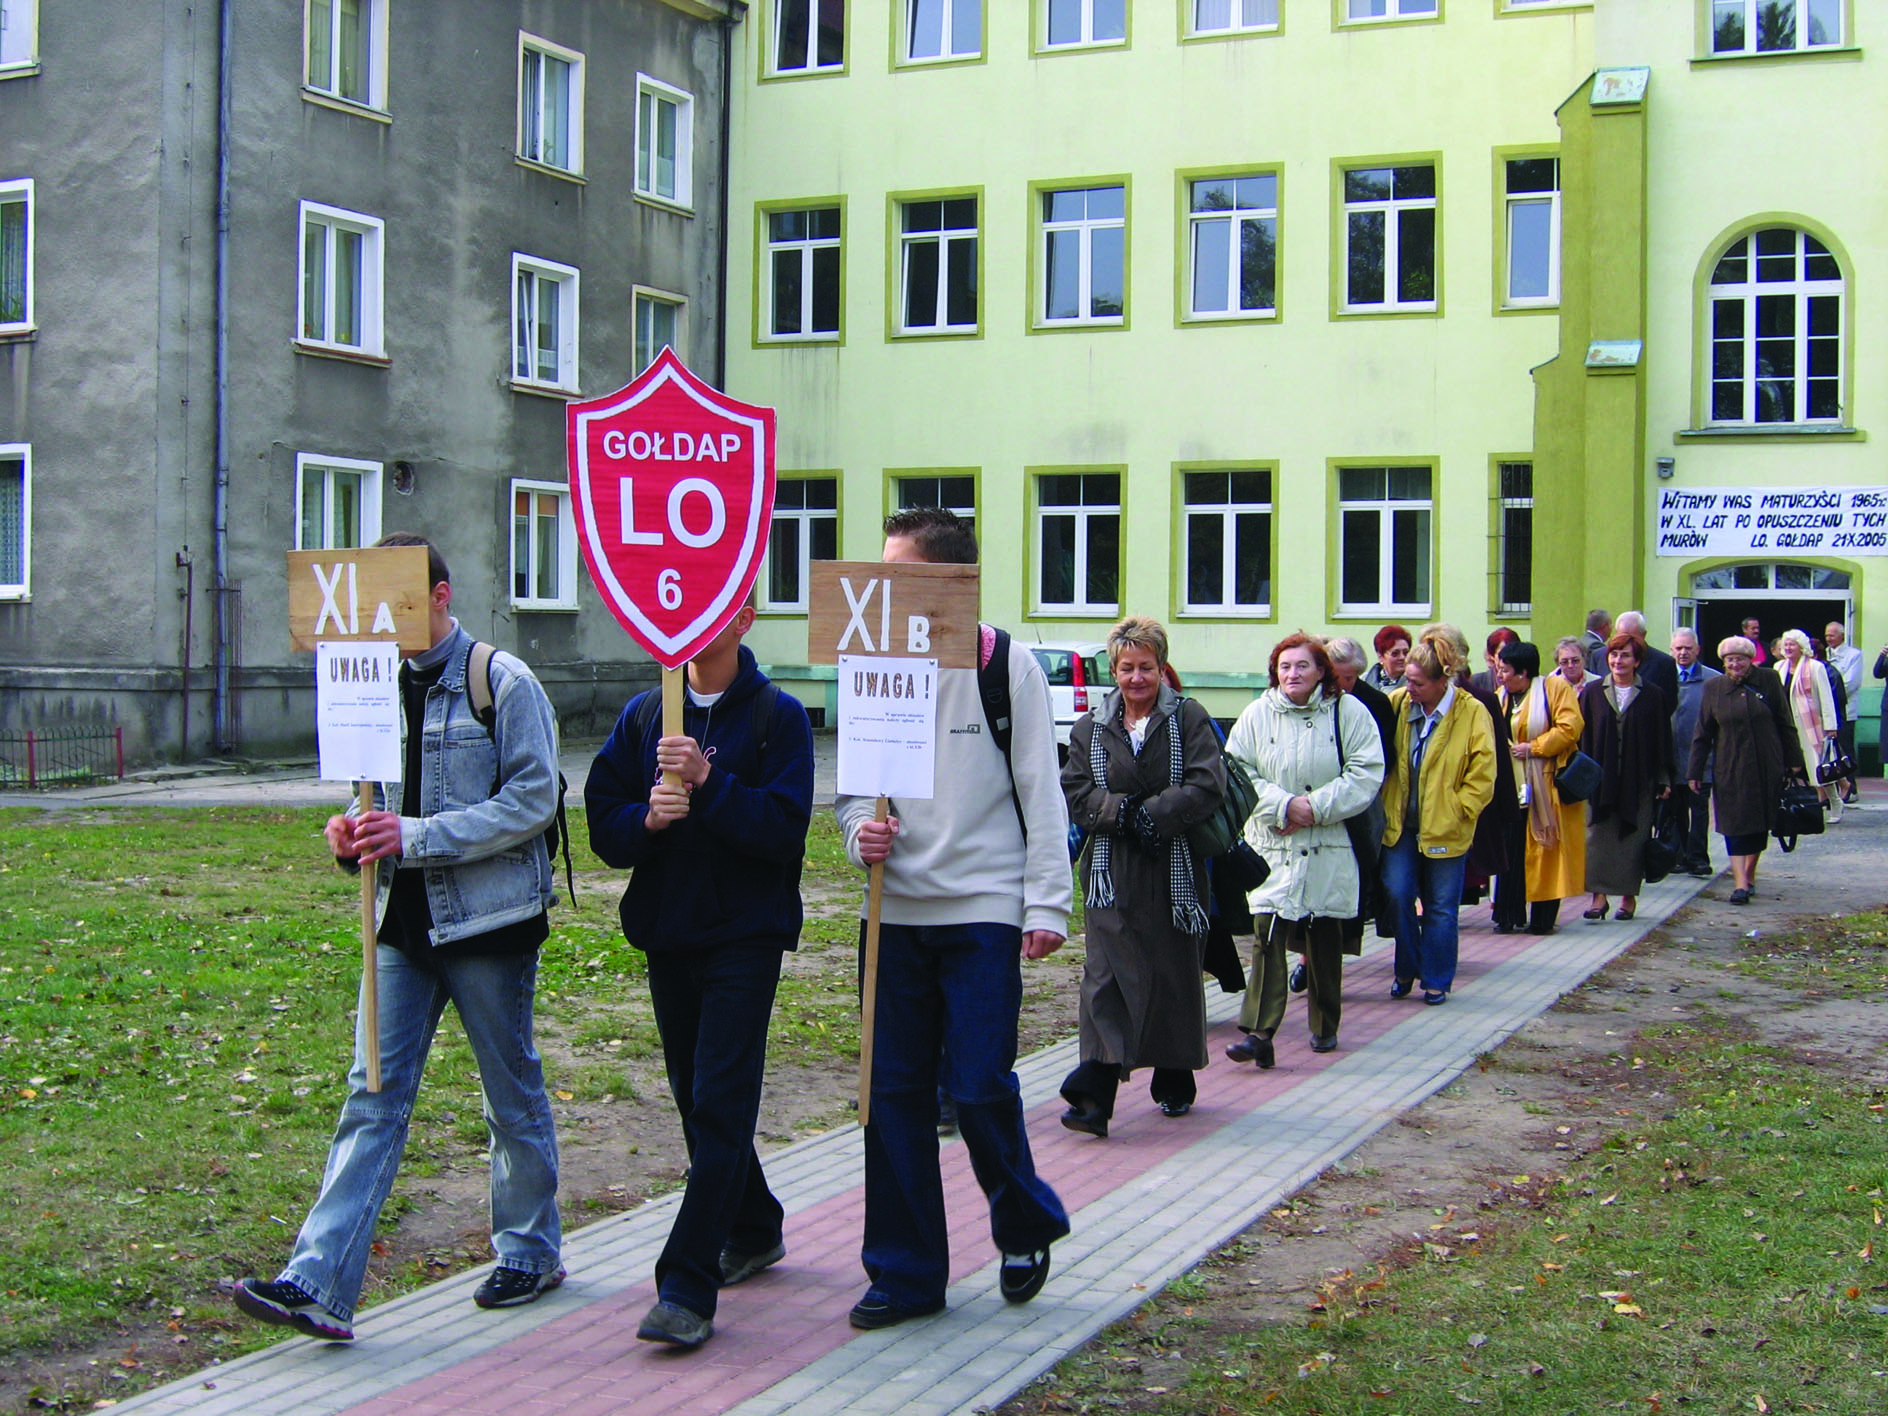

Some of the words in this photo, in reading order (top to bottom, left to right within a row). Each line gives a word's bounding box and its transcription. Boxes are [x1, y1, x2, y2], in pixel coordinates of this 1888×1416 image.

[603, 430, 742, 463] GOŁDAP
[619, 476, 727, 549] LO
[1723, 494, 1752, 508] WAS
[1760, 490, 1841, 508] MATURZYŚCI
[1661, 514, 1674, 528] W
[1676, 514, 1696, 528] XL.
[1702, 514, 1728, 528] LAT
[1735, 514, 1751, 528] PO
[1757, 513, 1843, 528] OPUSZCZENIU
[1852, 513, 1887, 527] TYCH
[1660, 530, 1708, 547] MURÓW
[1750, 533, 1768, 547] LO.
[1776, 533, 1824, 547] GOŁDAP
[312, 562, 360, 636] XI
[371, 602, 398, 634] A
[656, 568, 683, 611] 6
[836, 577, 891, 652] XI
[907, 615, 931, 653] B
[330, 656, 380, 683] UWAGA
[854, 670, 915, 699] UWAGA
